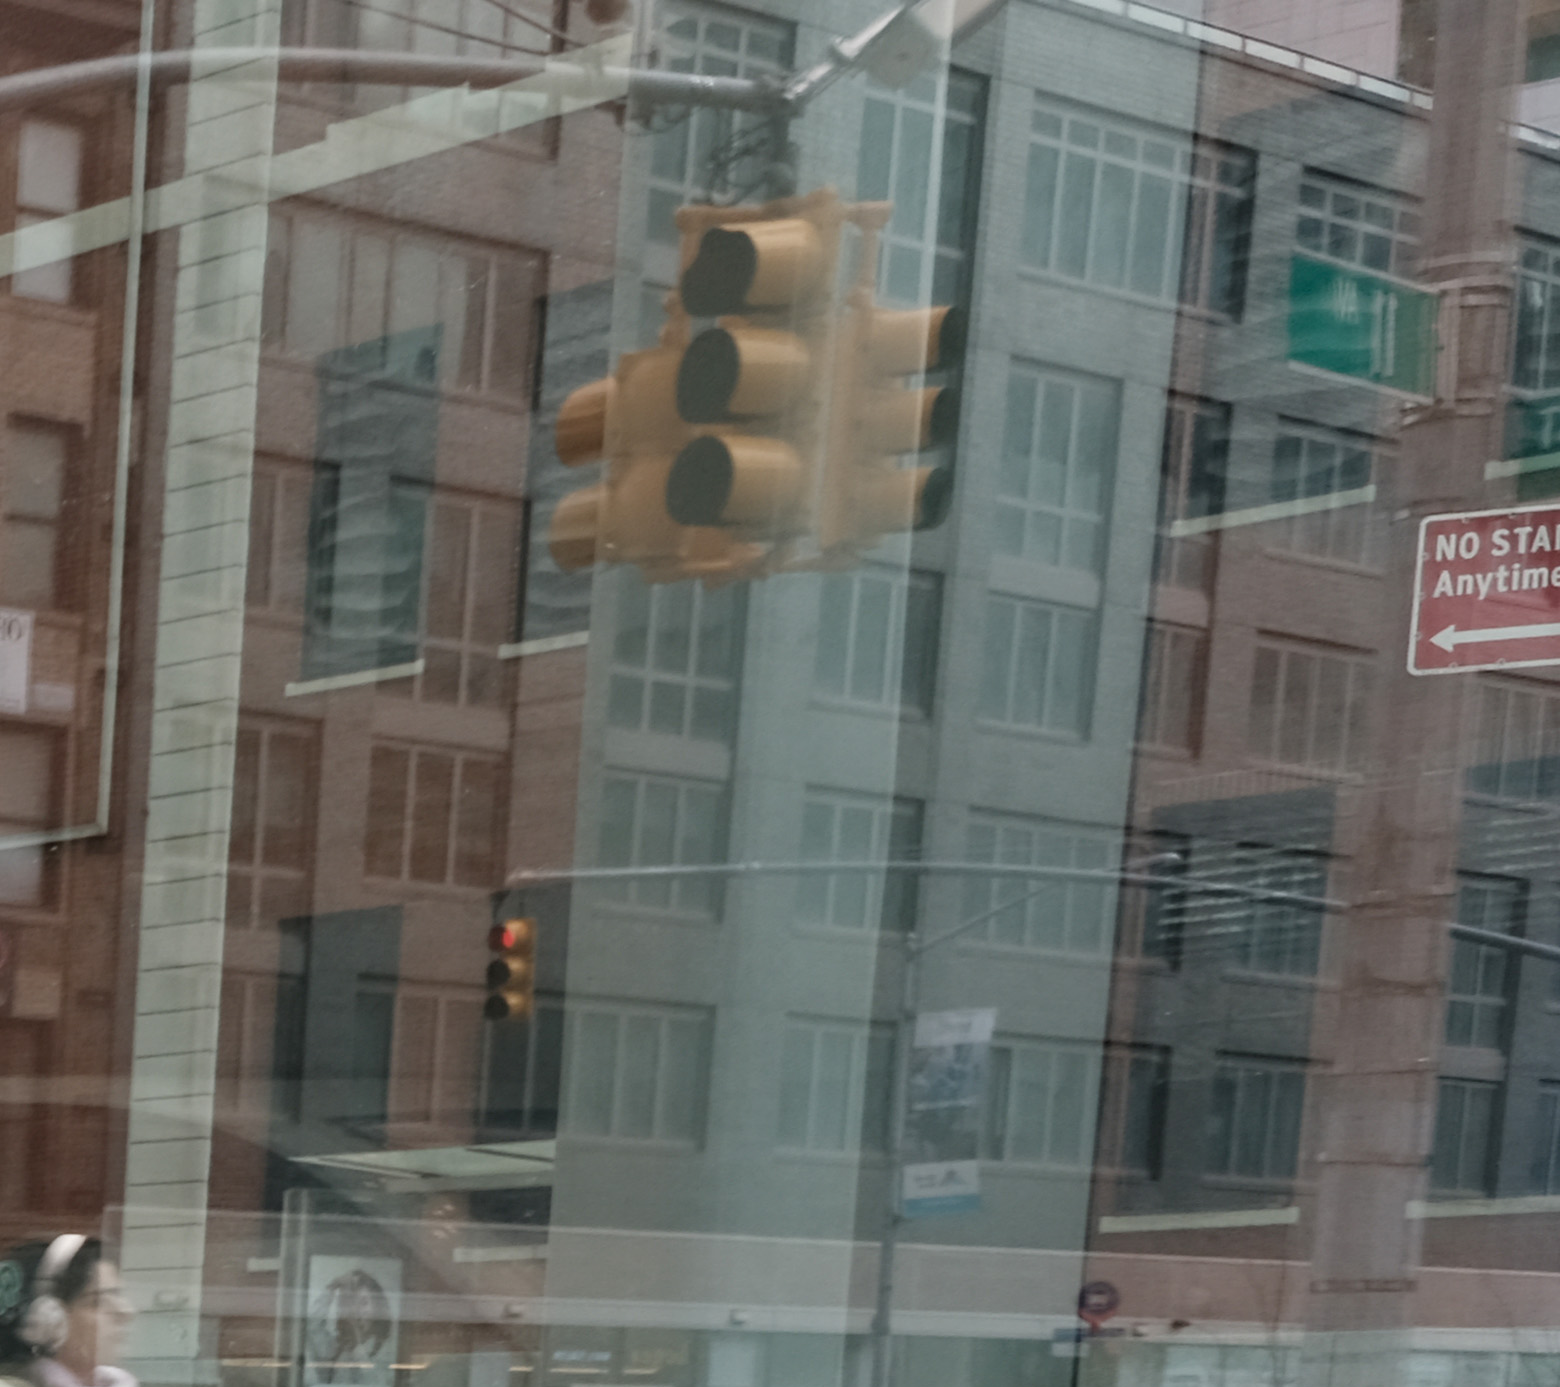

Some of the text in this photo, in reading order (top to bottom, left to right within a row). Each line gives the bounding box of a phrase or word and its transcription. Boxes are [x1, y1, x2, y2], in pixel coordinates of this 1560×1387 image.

[1435, 524, 1560, 562] NO STA
[1432, 563, 1560, 600] Anytime
